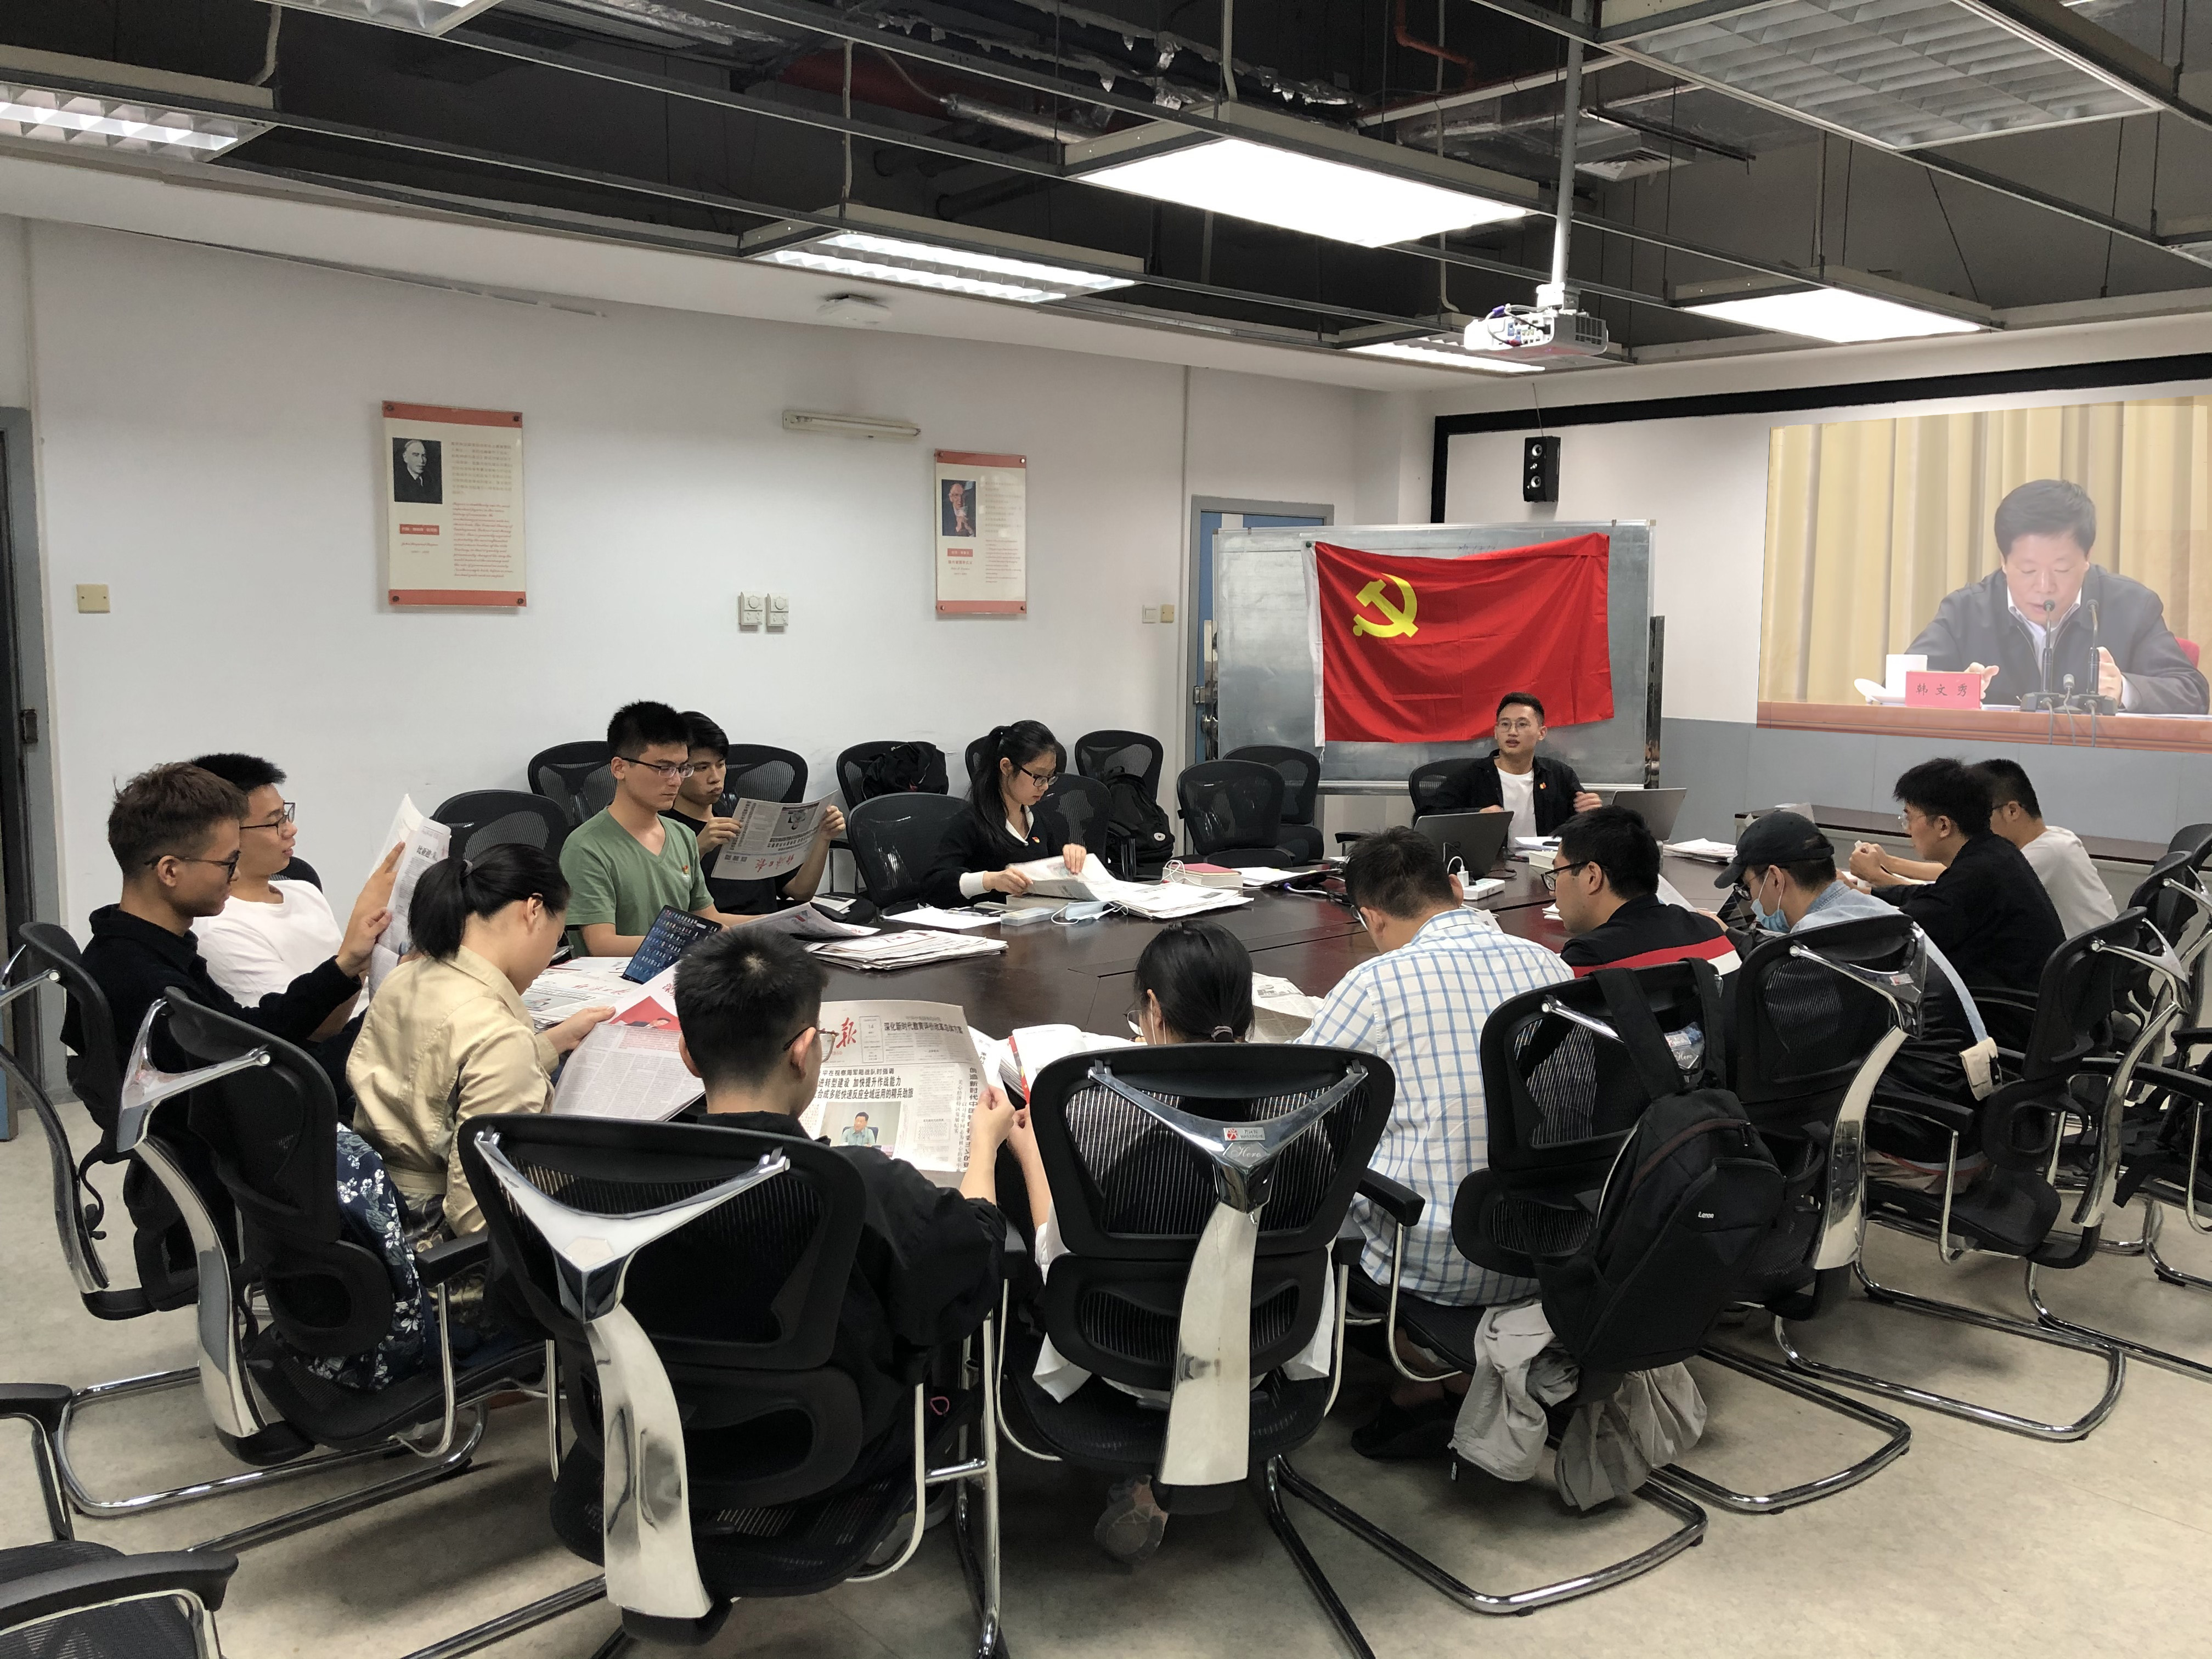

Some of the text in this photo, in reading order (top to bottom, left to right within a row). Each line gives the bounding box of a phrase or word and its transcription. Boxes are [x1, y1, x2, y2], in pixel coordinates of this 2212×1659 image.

[1916, 682, 1967, 697] 韩文秀
[820, 1068, 895, 1076] 平在视察海军陆战队时强调
[815, 1088, 914, 1099] 合成多能快速反应全域运用的精兵劲旅
[1231, 1146, 1262, 1158] Hero
